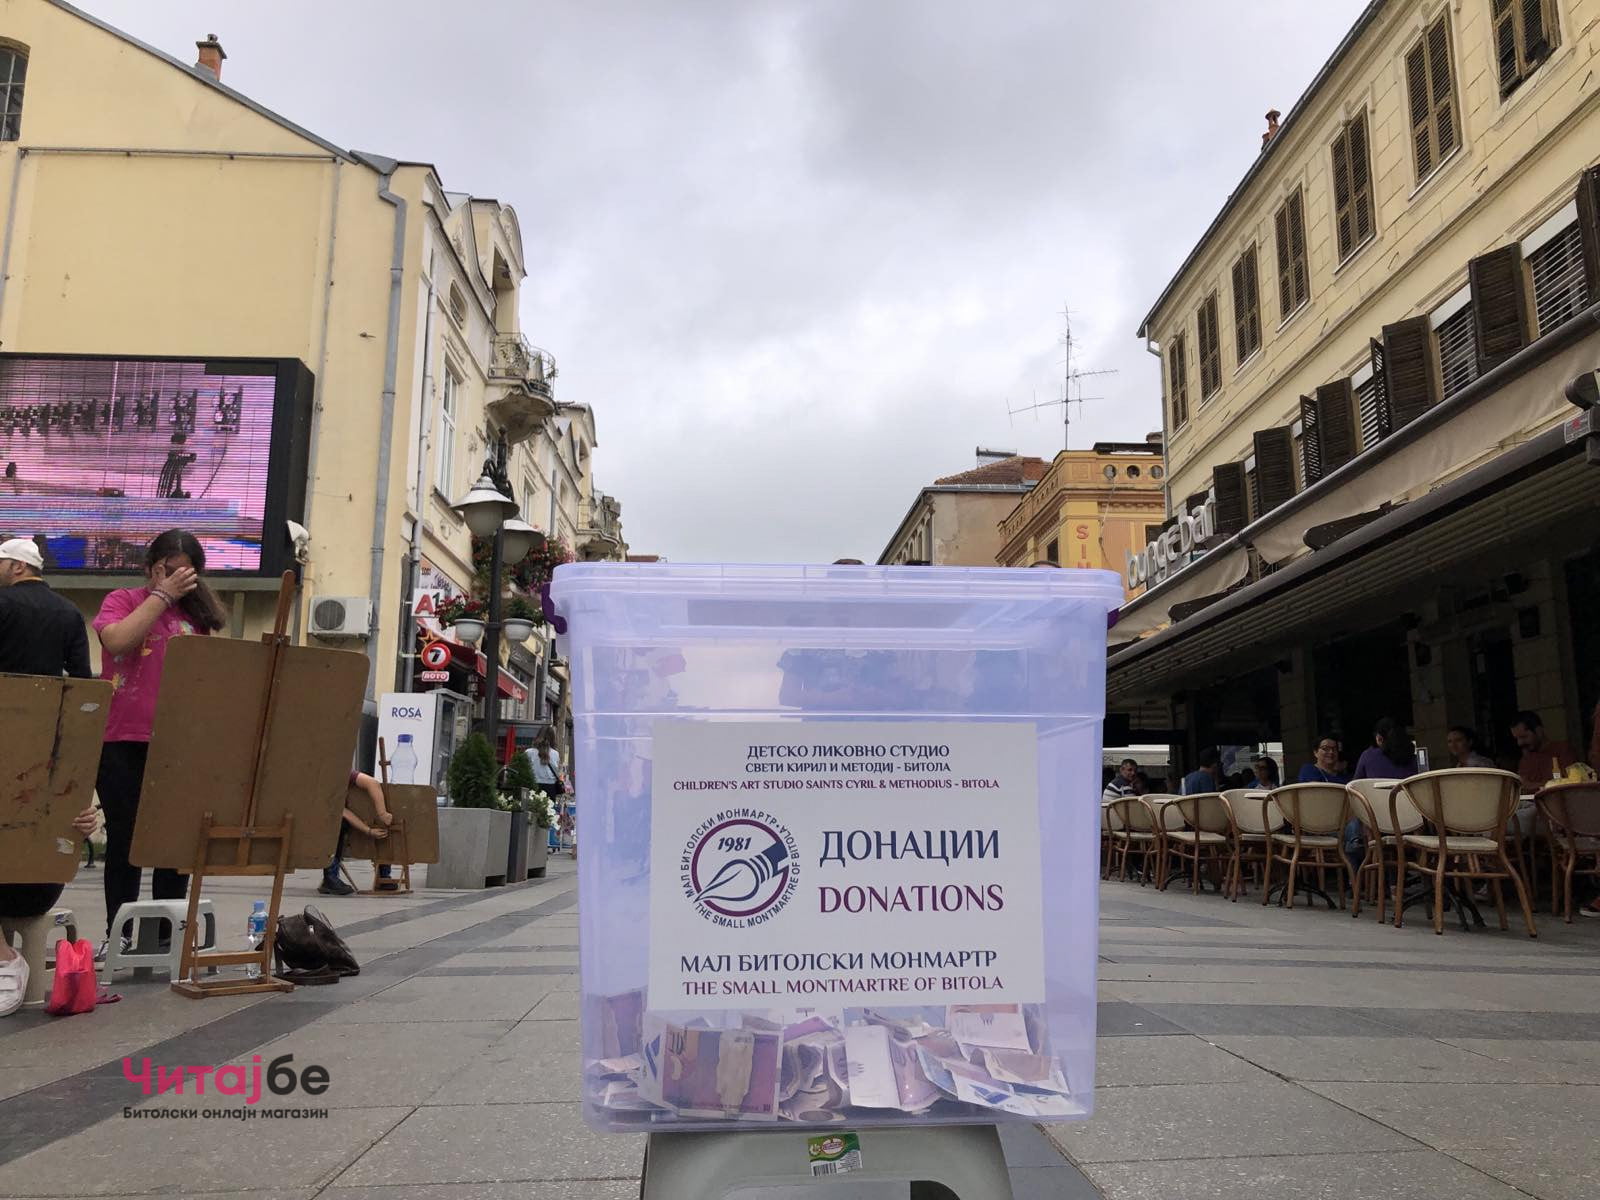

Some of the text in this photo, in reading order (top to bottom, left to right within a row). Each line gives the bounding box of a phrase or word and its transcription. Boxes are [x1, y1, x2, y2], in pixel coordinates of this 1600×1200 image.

[429, 649, 441, 663] 7
[391, 706, 422, 718] ROSA
[747, 744, 950, 760] ДЕТСКО ЛИКОВНО СТУДИО
[745, 762, 784, 773] СВЕТИ
[787, 762, 827, 773] КИРИЛ
[830, 762, 838, 772] И
[840, 762, 894, 774] МЕТОДИЈ
[904, 762, 951, 772] БИТОЛА
[673, 780, 737, 790] CHILDREN'S
[740, 780, 760, 790] ART
[763, 780, 803, 790] STUDIO
[805, 780, 843, 789] SAINTS
[845, 779, 878, 789] CYRIL
[879, 779, 887, 789] &
[889, 779, 952, 789] METHODIUS
[961, 779, 1000, 788] BITOLA
[680, 808, 778, 898] МАЛ БИТОЛСКИ МОНМАРТР
[717, 836, 752, 853] 1981
[819, 829, 999, 868] ДОНАЦИИ
[695, 825, 801, 929] THE SMALL MONTMARTRE OF BITOLA
[818, 884, 1005, 914] DONATIONS
[681, 950, 997, 973] МАЛ БИТОЛСКИ МОНМАРТР
[682, 975, 1004, 995] THE SMALL MONTMARTRE OF BITOLA
